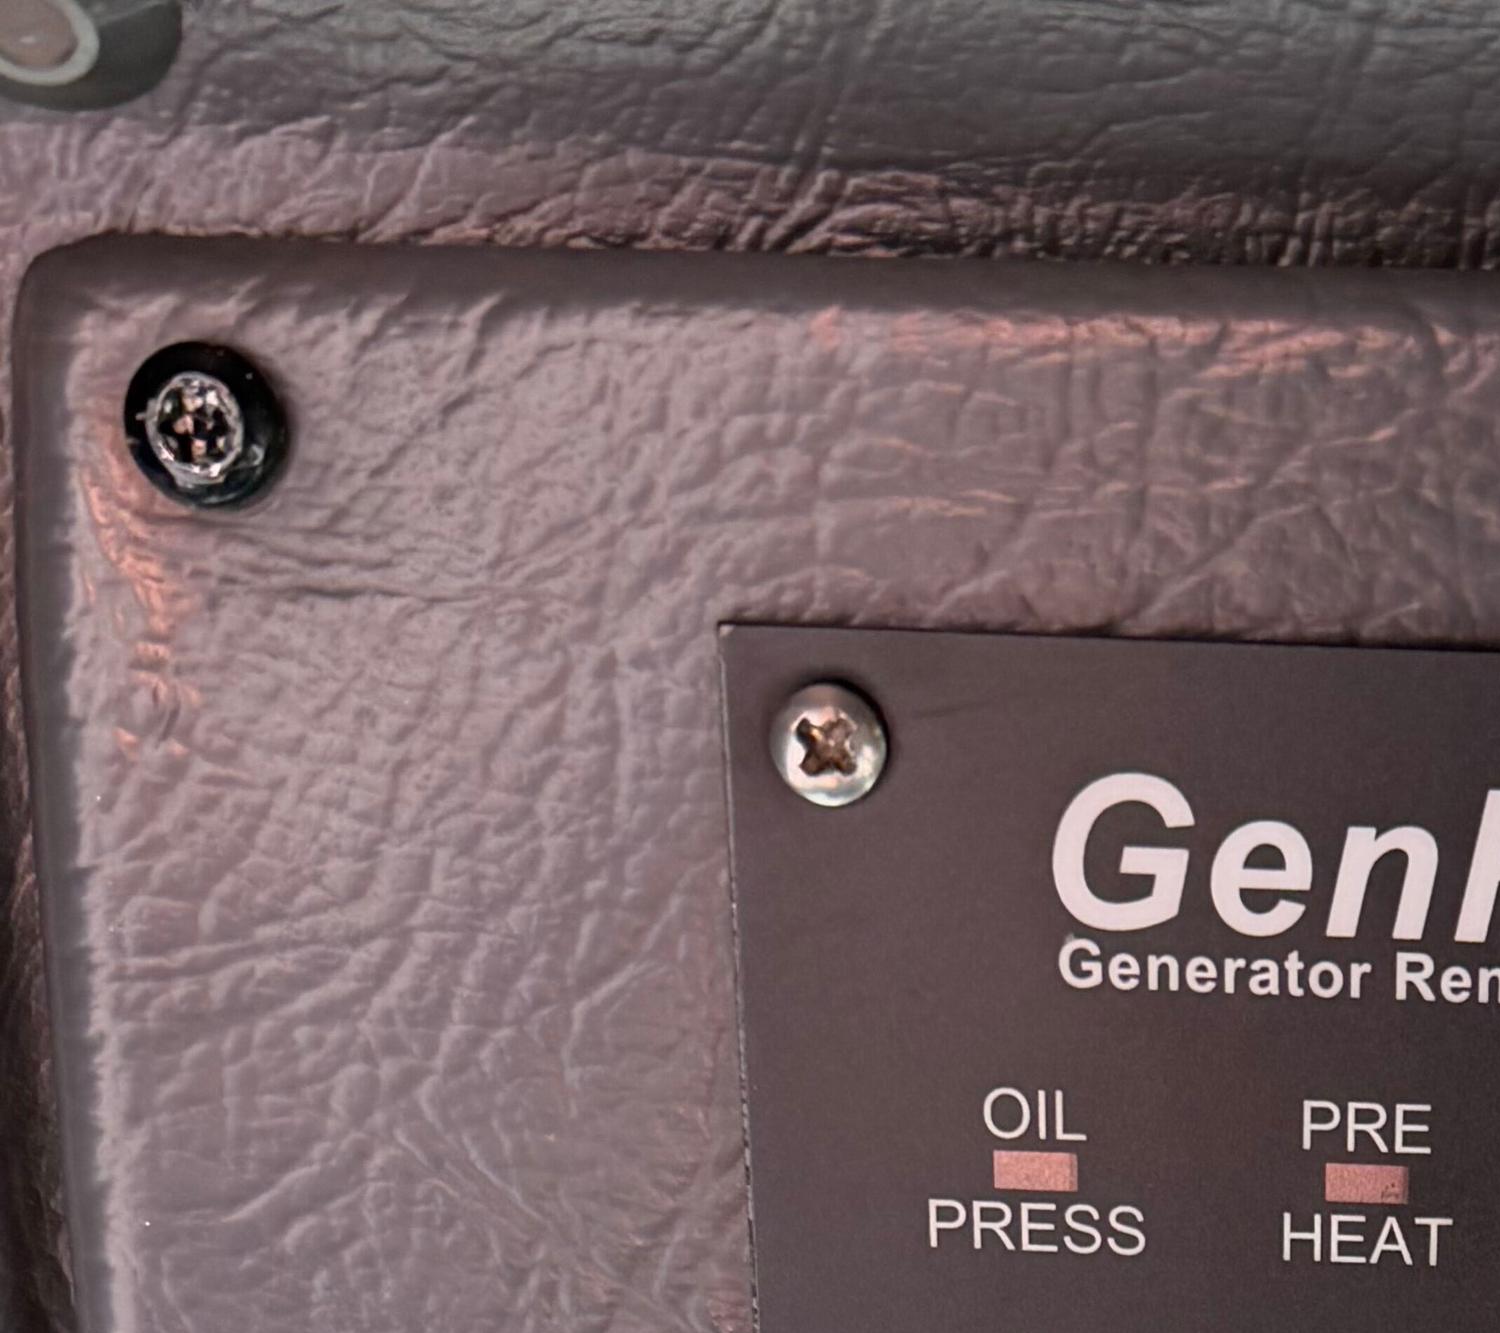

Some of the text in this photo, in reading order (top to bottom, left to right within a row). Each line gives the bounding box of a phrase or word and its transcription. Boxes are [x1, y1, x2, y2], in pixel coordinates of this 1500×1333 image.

[1058, 938, 1372, 999] Generator
[983, 1087, 1087, 1141] OIL
[1302, 1099, 1432, 1154] PRE
[928, 1198, 1147, 1257] PRESS
[1282, 1212, 1454, 1266] HEAT
